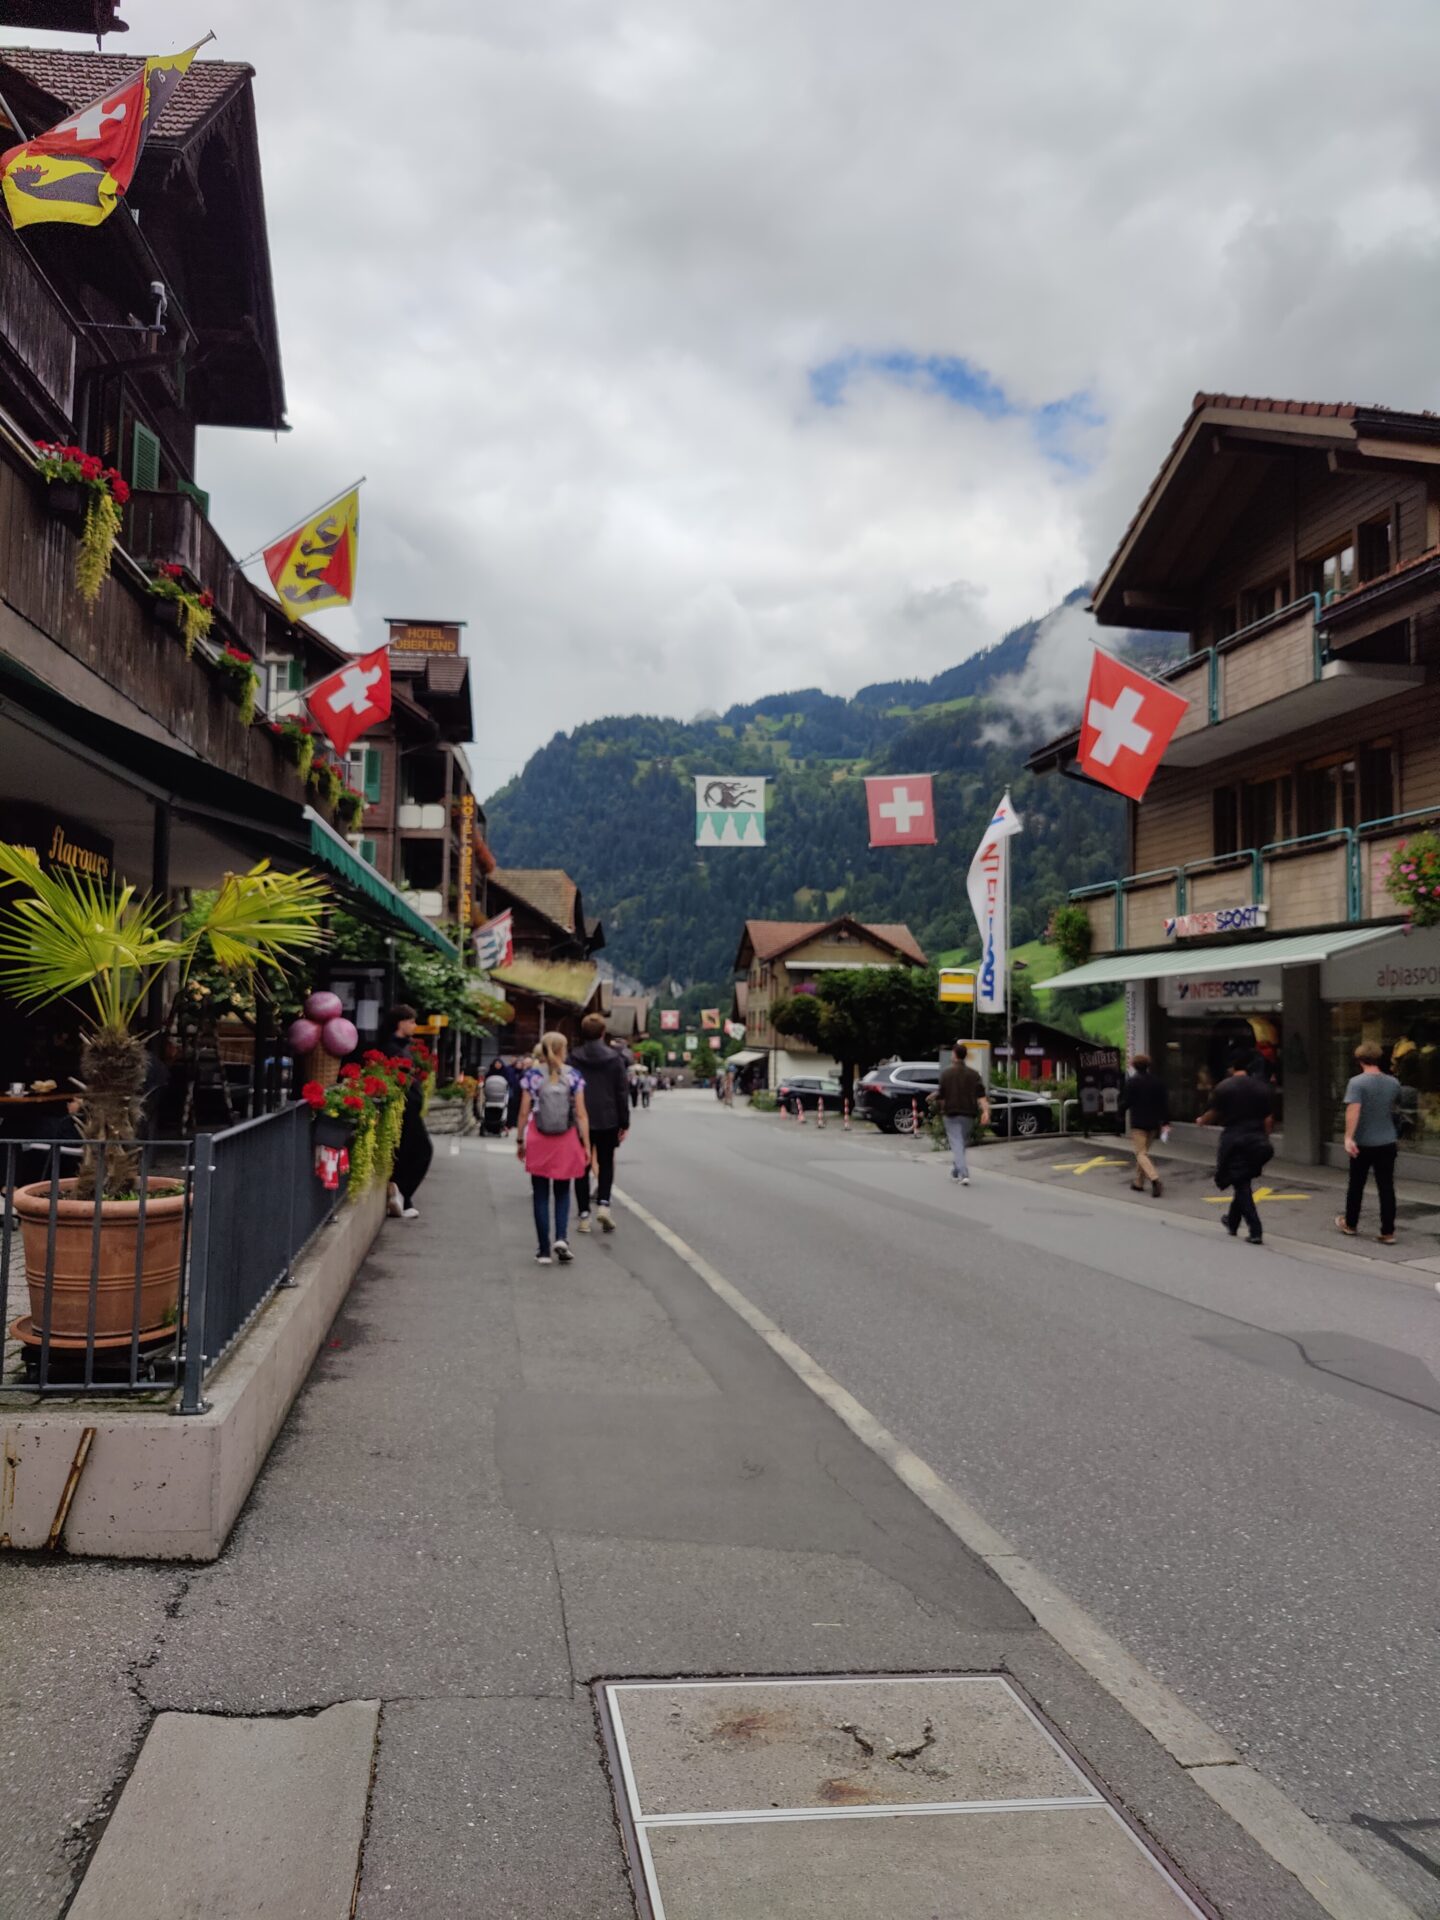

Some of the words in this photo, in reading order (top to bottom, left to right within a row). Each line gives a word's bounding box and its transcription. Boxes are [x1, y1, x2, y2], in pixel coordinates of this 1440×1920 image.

[406, 628, 445, 640] HOTEL
[394, 640, 457, 652] OBERLAND
[461, 795, 474, 844] HOTEL
[1189, 980, 1261, 998] INTERSPORT
